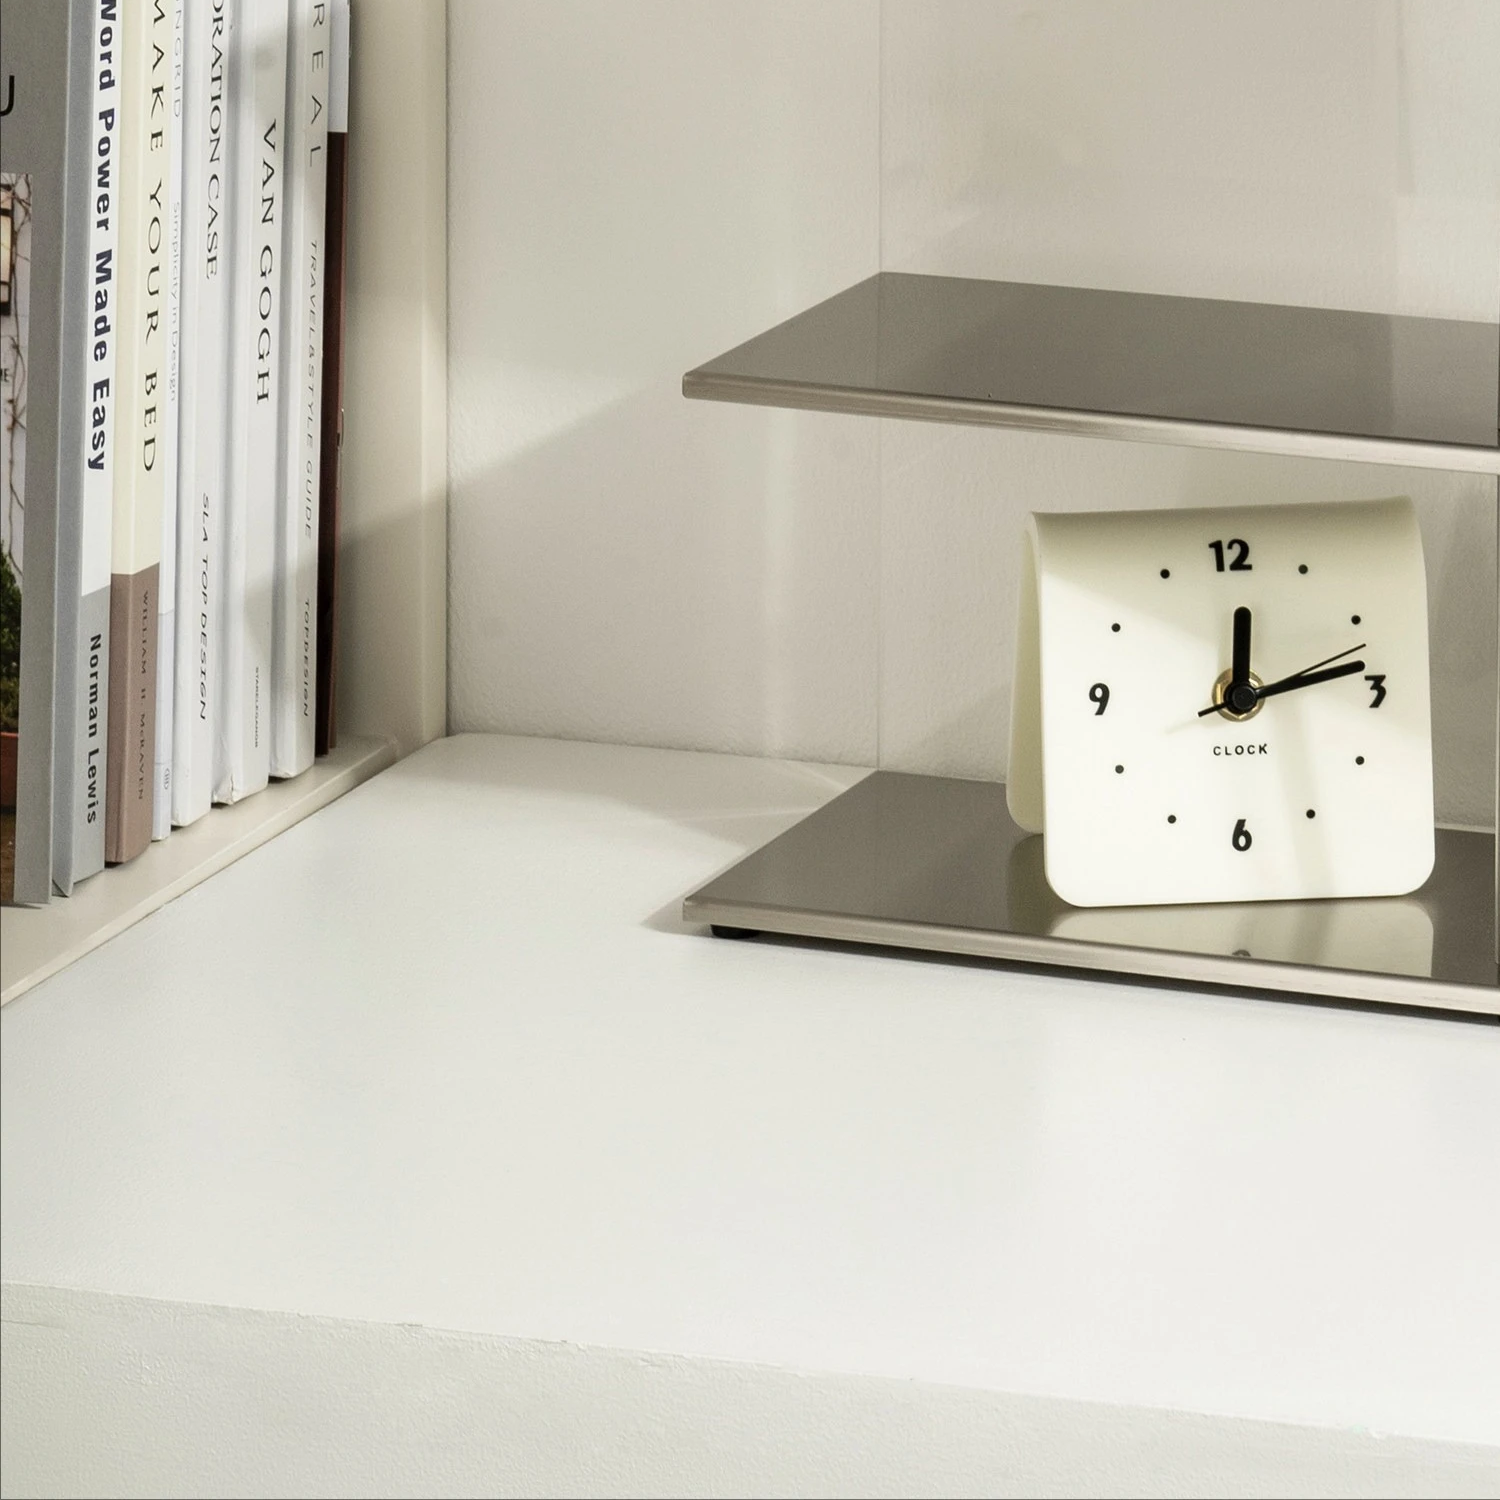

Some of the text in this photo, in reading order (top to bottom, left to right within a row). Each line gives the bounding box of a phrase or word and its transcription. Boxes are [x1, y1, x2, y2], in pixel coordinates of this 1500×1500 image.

[96, 107, 115, 231] Power
[146, 177, 162, 345] YOUR
[170, 202, 180, 301] Simplicity
[206, 172, 220, 280] CASE
[257, 118, 277, 404] VAN GOGH
[94, 248, 112, 362] Made
[168, 330, 179, 402] Design
[88, 377, 110, 470] Easy
[143, 371, 158, 473] BED
[304, 460, 313, 539] GUIDE
[1207, 538, 1254, 573] 12
[141, 590, 149, 675] WILLIAM
[199, 492, 210, 721] SLA TOP DESIGN
[87, 633, 102, 824] Norman Lewis
[1088, 682, 1111, 716] 9
[1363, 674, 1387, 708] 3
[1212, 742, 1269, 757] CLOCK
[1231, 818, 1253, 852] 6
